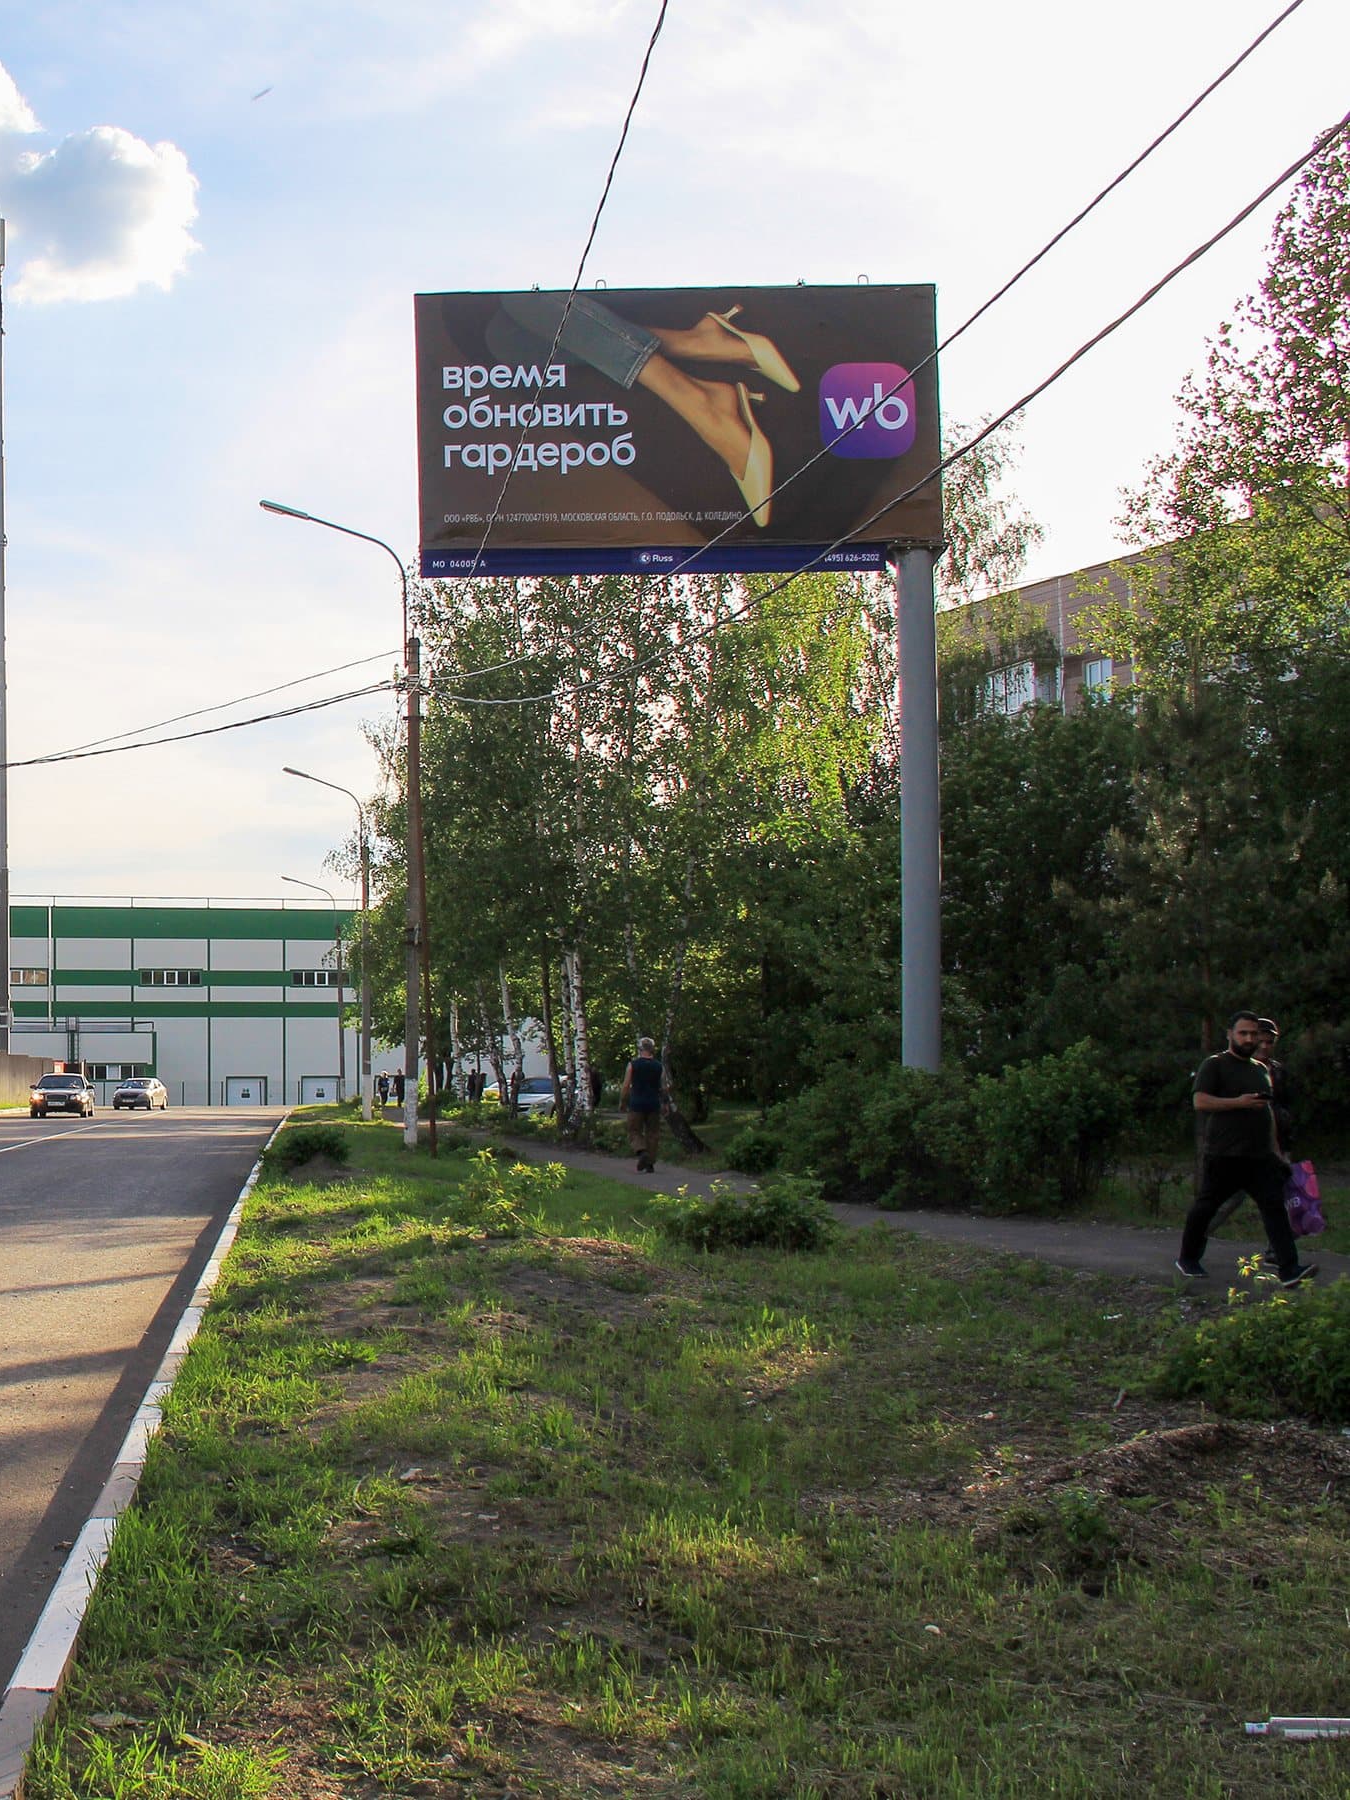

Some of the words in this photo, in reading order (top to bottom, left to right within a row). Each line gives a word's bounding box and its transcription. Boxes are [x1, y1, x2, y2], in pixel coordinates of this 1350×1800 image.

[442, 364, 566, 397] время
[443, 394, 629, 429] обновить
[824, 382, 909, 430] wb
[443, 432, 637, 475] гардероб
[444, 513, 460, 523] ООО
[486, 513, 504, 523] ОРН
[561, 512, 607, 522] МОСКОВСКАЯ
[608, 512, 640, 522] ОБЛАСТЬ,
[656, 511, 694, 522] ПОДОЛЬСК,
[704, 511, 742, 521] КОЛЕДИНО
[432, 560, 446, 568] МО
[652, 554, 673, 562] Russ
